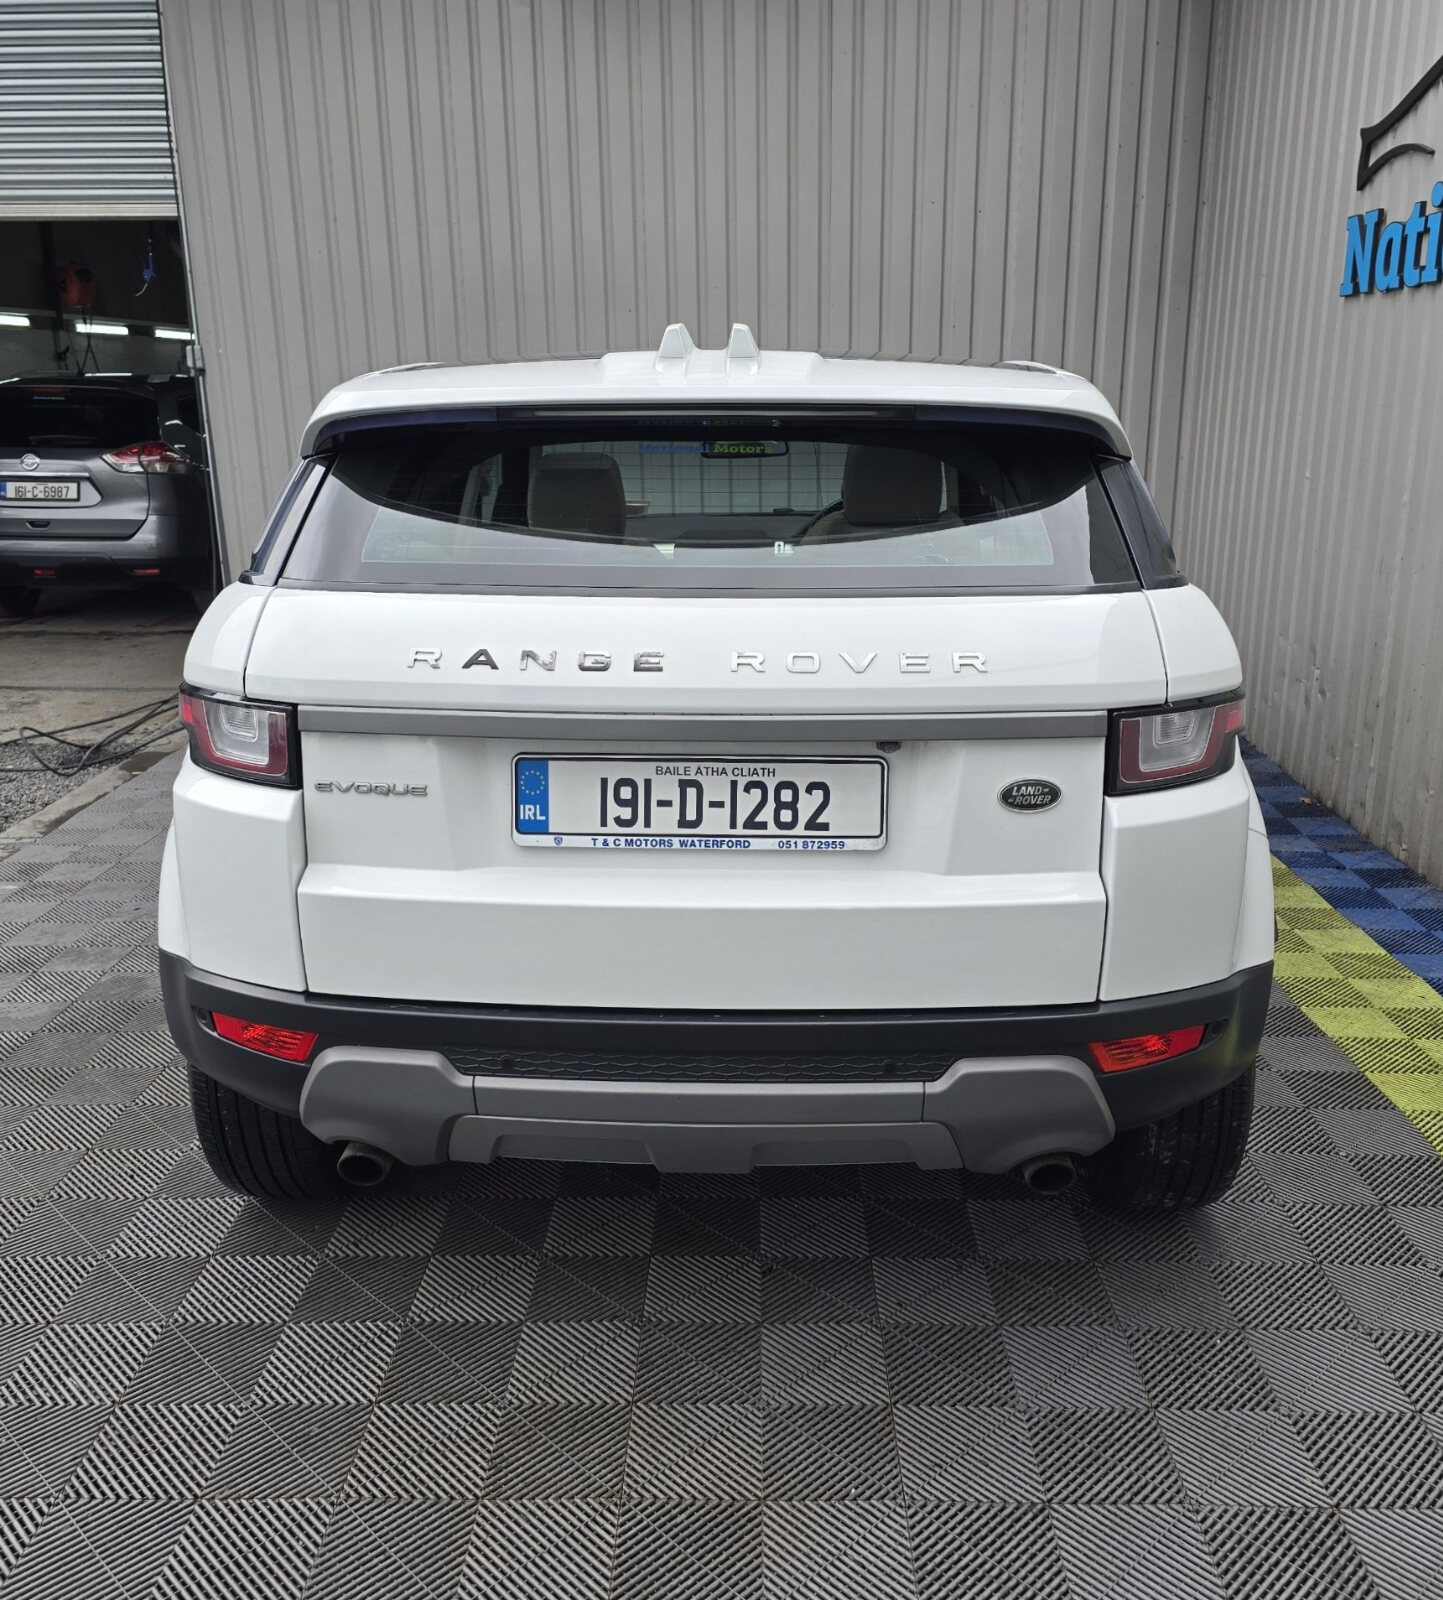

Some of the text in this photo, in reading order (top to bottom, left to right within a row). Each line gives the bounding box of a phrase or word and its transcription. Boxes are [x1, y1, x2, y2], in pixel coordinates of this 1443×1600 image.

[1340, 181, 1443, 298] Nati
[14, 486, 70, 498] 161-C-6987
[407, 647, 989, 673] RANGE ROVER
[655, 765, 691, 776] BAILE
[731, 767, 776, 778] CLIATH
[315, 781, 428, 797] EVOQUE
[519, 804, 546, 820] IRL
[600, 777, 831, 831] 191-D-1282
[591, 837, 845, 849] T & C MOTORS WATERFORD 051 872959
